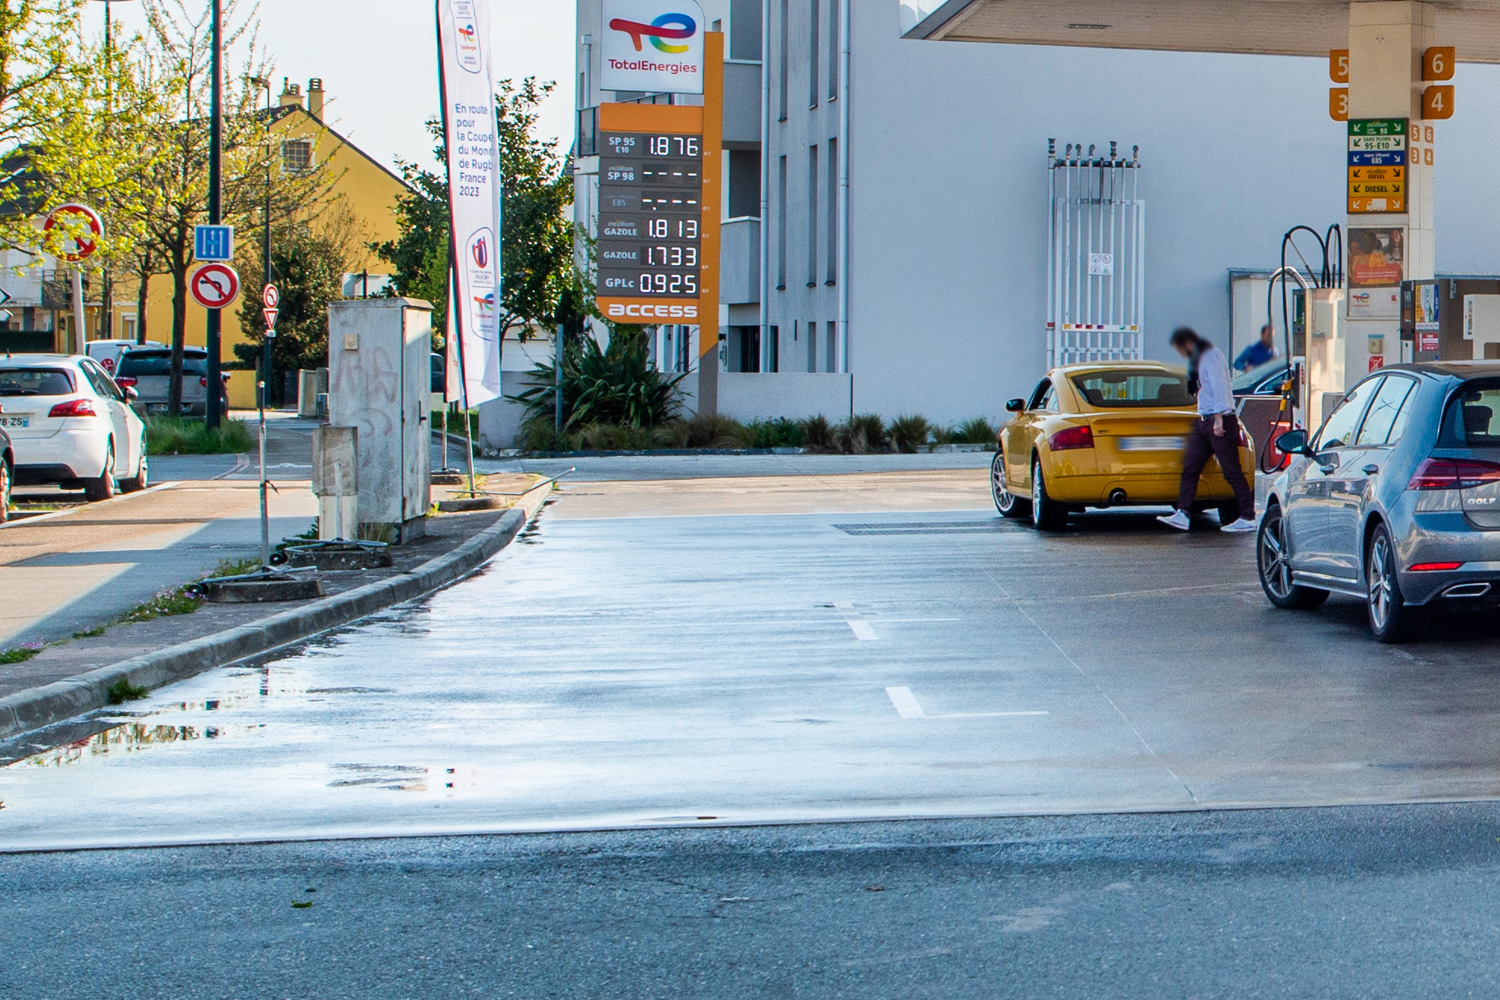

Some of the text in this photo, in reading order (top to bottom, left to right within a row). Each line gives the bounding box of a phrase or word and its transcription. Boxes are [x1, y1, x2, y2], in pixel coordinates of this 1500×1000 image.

[608, 59, 697, 75] TotalEnergies
[1337, 56, 1349, 76] 5
[1432, 53, 1444, 74] 6
[1337, 94, 1349, 114] 3
[1431, 92, 1444, 112] 4
[455, 103, 488, 114] En route
[456, 119, 475, 128] pour
[457, 130, 493, 142] la Coupe
[1413, 127, 1418, 139] 5
[1426, 129, 1432, 140] 6
[609, 136, 636, 146] SP 95
[650, 136, 698, 157] 1.876
[458, 145, 469, 155] du
[615, 146, 630, 154] E10
[1413, 149, 1418, 162] 3
[1426, 151, 1432, 163] 4
[458, 159, 470, 169] de
[459, 171, 487, 184] France
[607, 171, 635, 181] SP 98
[459, 185, 480, 197] 2023
[604, 228, 638, 236] GAZOLE
[649, 219, 698, 239] 1.813
[603, 251, 637, 260] GAZOLE
[648, 246, 697, 267] 1.733
[605, 278, 635, 288] GPLc
[640, 273, 697, 294] 0.925
[1467, 497, 1497, 505] GOLF
